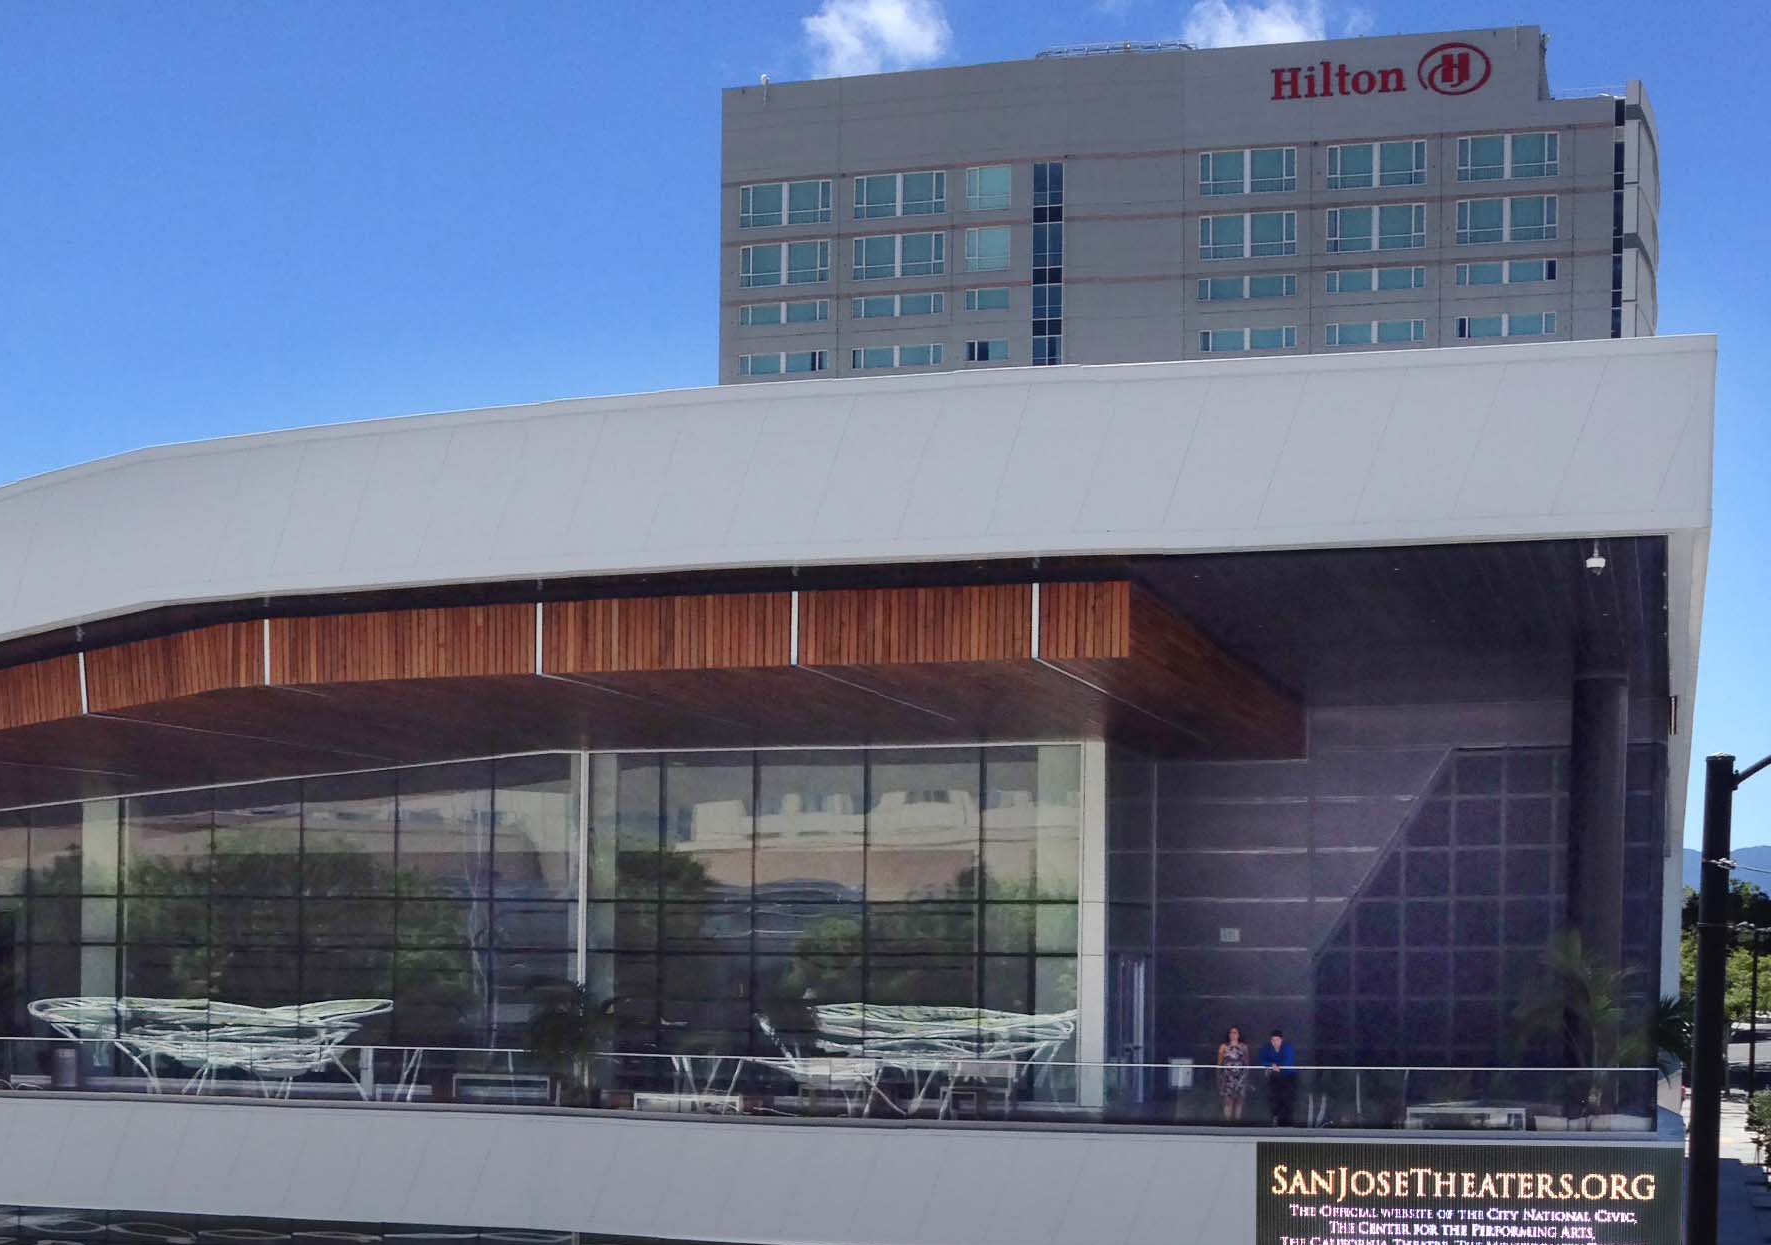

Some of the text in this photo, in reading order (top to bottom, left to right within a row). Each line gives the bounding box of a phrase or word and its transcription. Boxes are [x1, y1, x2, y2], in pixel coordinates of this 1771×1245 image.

[1270, 61, 1407, 101] Hilton
[1289, 1203, 1638, 1225] THE OFFICIAL WEBSITE OF THE CITY NATIONAL CIVIC,
[1329, 1221, 1596, 1241] THE CENTER FOR THE PERFORMING ARTS,
